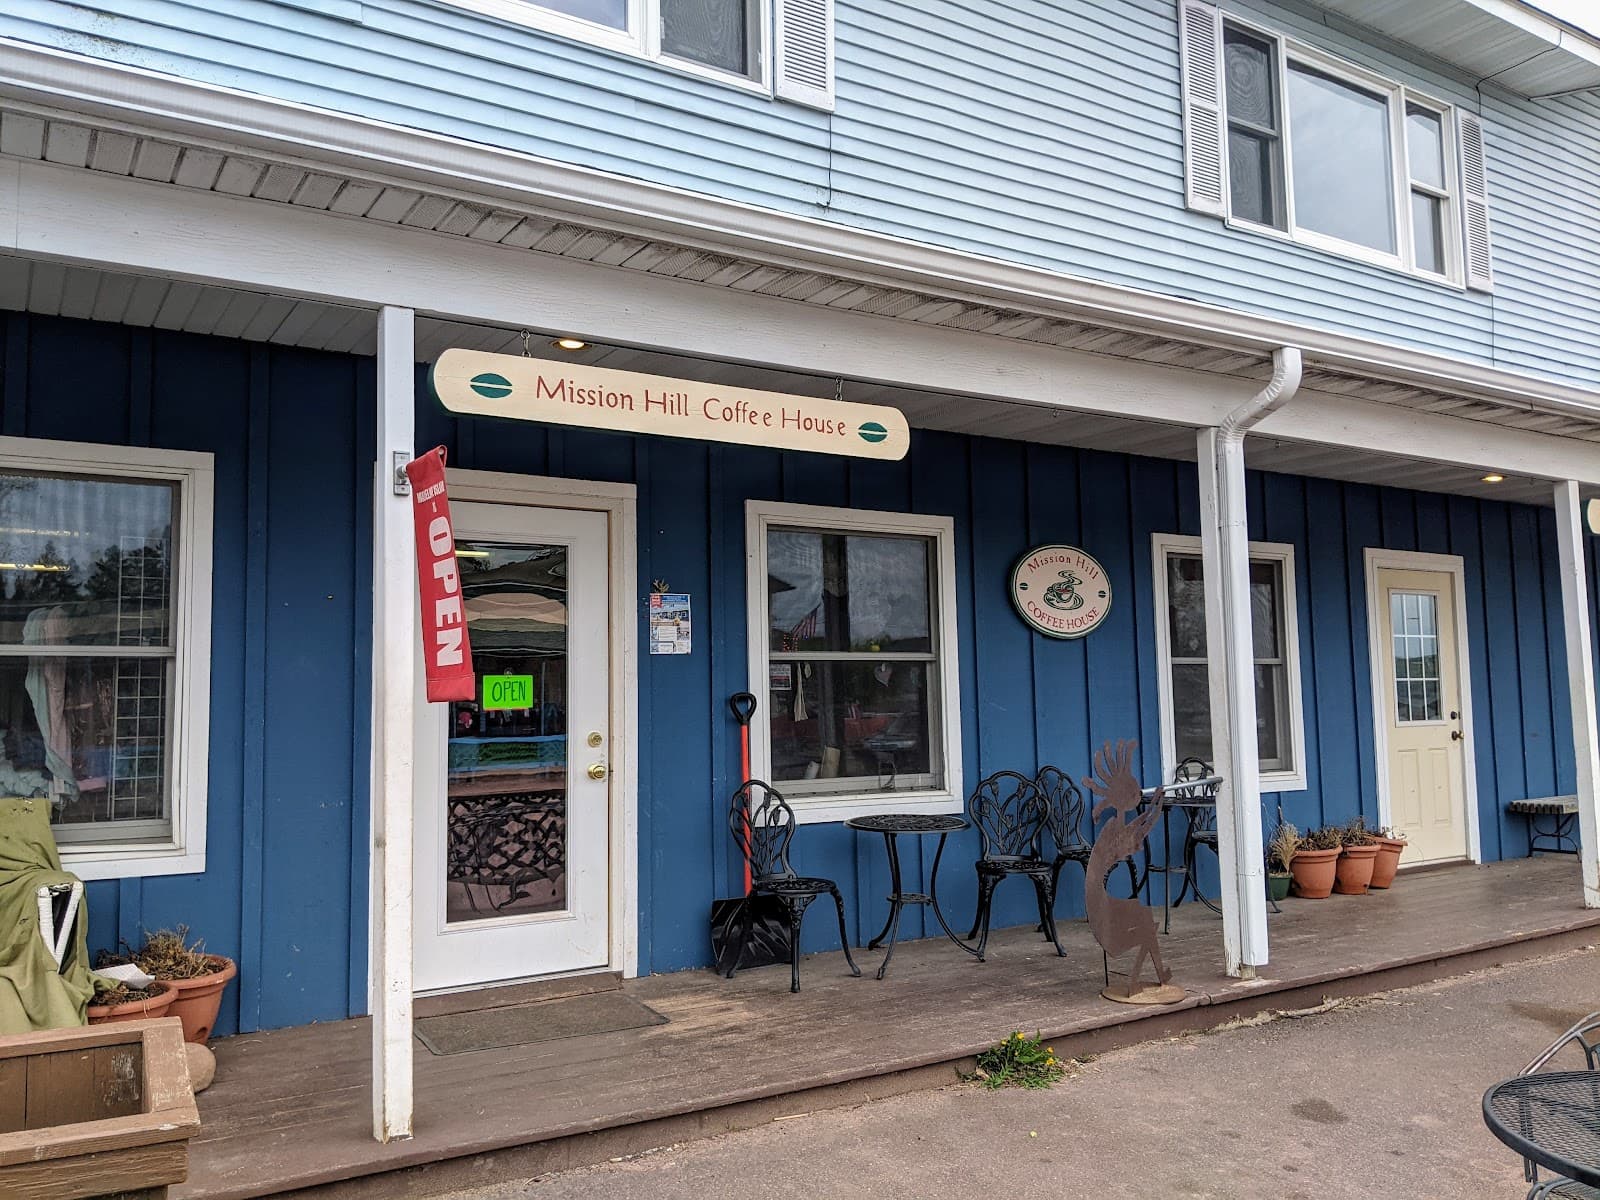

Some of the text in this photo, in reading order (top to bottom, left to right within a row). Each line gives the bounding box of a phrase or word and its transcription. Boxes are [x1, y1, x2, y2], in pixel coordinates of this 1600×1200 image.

[536, 375, 847, 436] Mission Hill Coffee House
[1027, 555, 1099, 580] Mission Hill
[428, 516, 464, 667] OPEN
[1027, 600, 1100, 630] COFFEE HOUSE
[491, 680, 526, 702] OPEN
